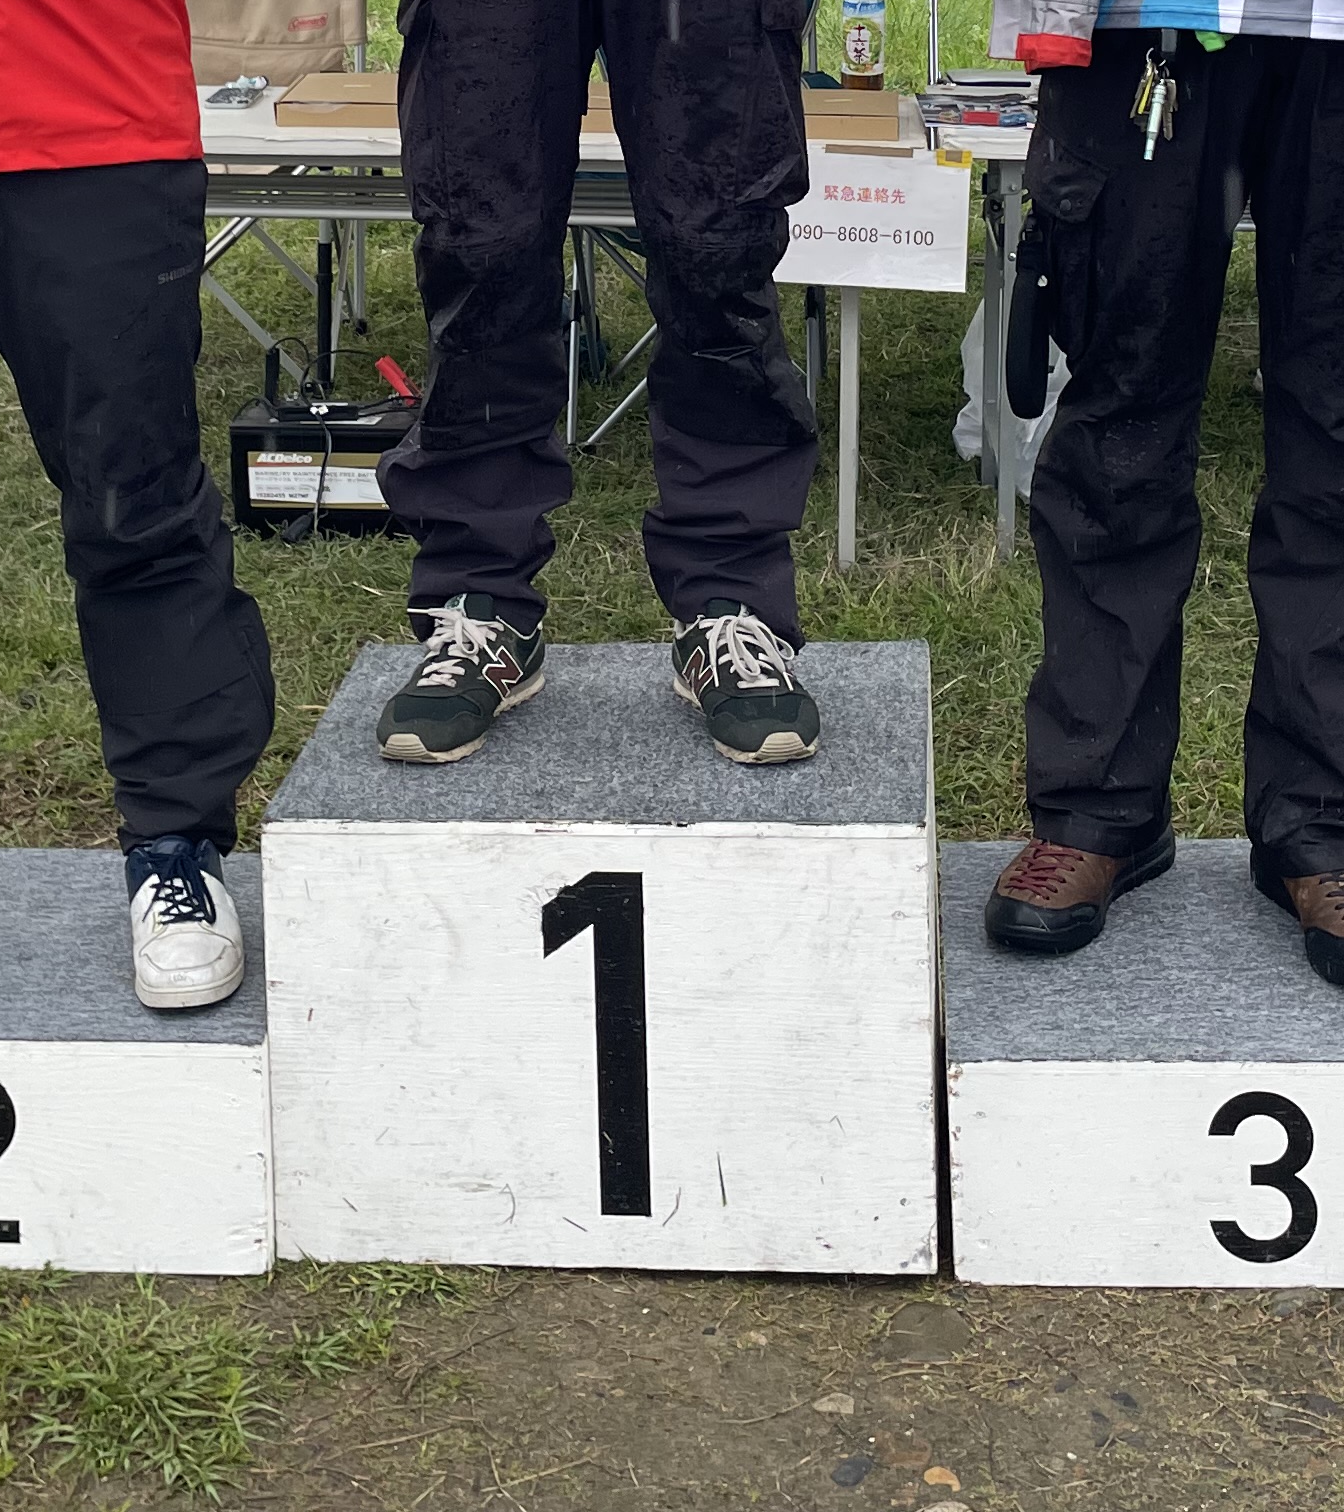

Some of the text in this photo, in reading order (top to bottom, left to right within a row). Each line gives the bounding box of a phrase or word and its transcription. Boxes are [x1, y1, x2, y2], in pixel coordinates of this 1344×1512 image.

[852, 24, 869, 65] 十六茶
[824, 185, 906, 204] 緊急連絡先
[257, 453, 312, 464] ACDelco
[542, 872, 651, 1218] 1
[1208, 1091, 1318, 1264] 3
